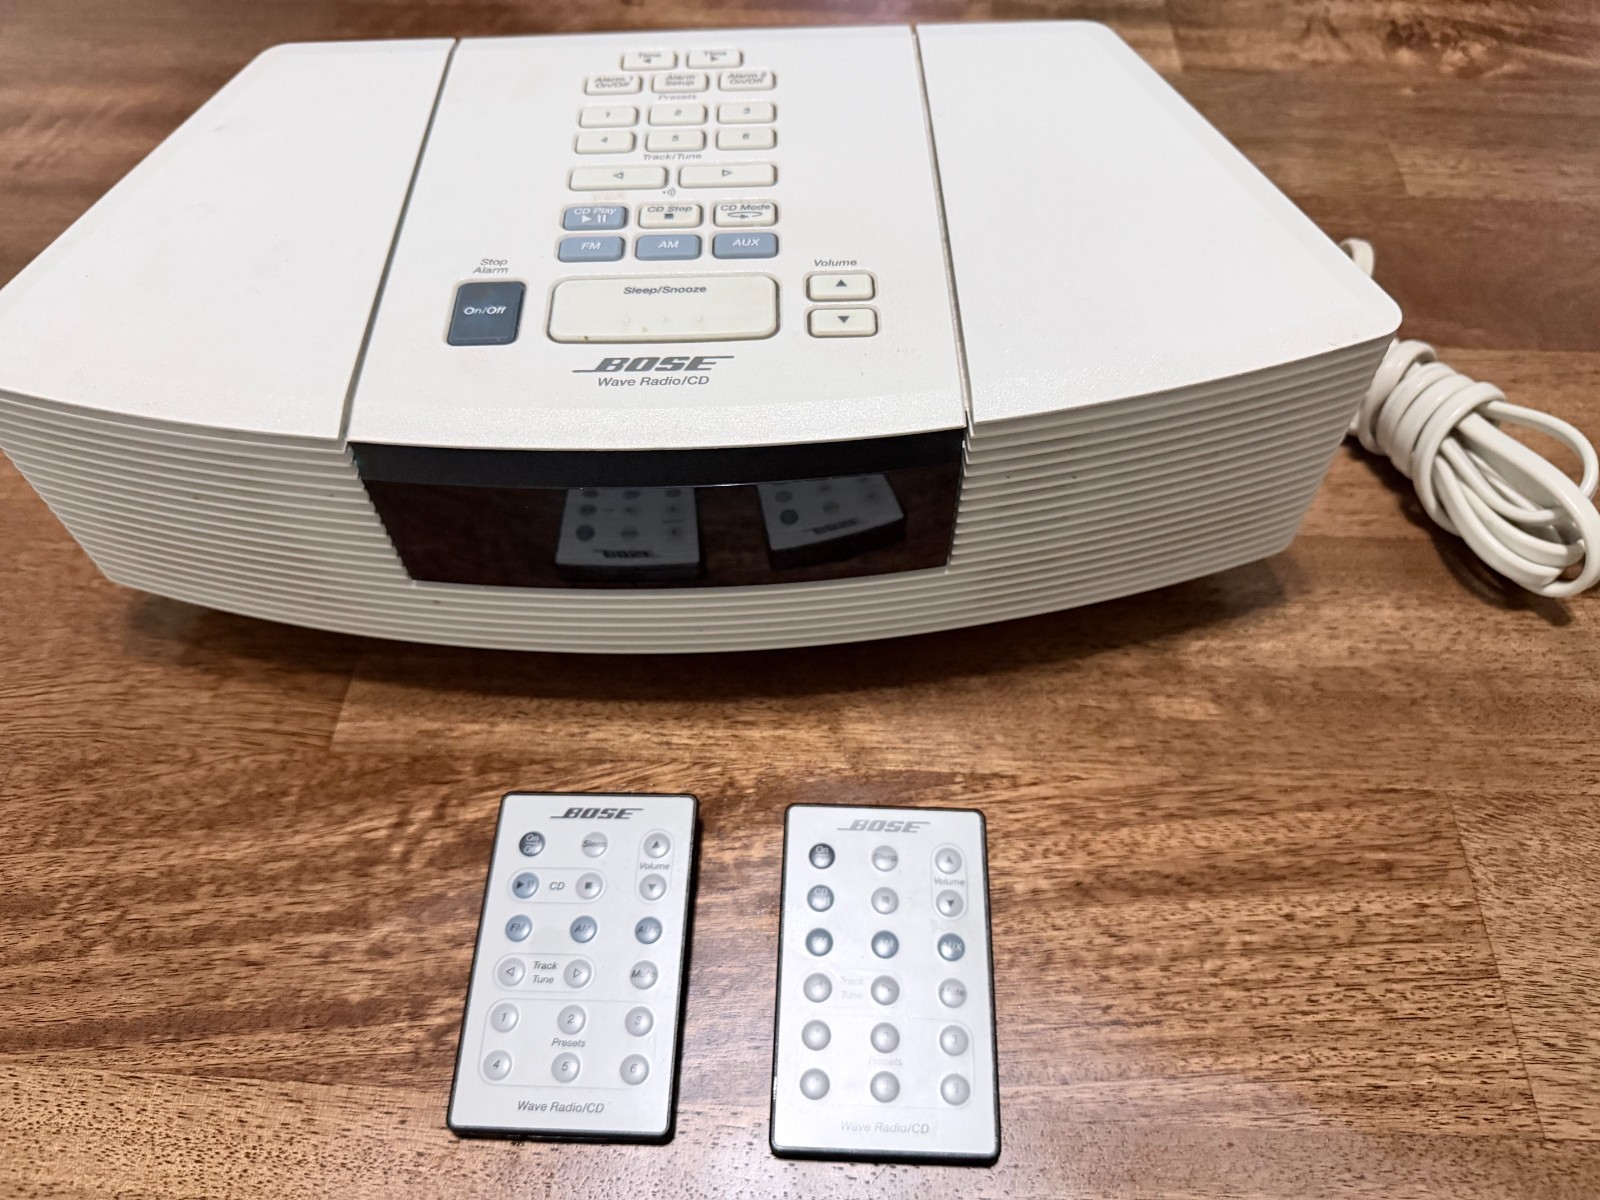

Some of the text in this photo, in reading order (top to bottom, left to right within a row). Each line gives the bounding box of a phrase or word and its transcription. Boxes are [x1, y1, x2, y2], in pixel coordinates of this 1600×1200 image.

[593, 207, 616, 216] Play
[667, 206, 692, 214] Stop
[581, 242, 601, 250] FM
[658, 240, 679, 249] AM
[733, 238, 760, 247] AUX
[480, 258, 508, 267] Stop
[814, 259, 857, 267] Volume
[473, 266, 508, 274] Alarm
[623, 285, 707, 296] Sleep/Snooze
[464, 305, 507, 315] On/Off
[573, 355, 734, 373] BOSE
[598, 375, 710, 386] Wave Radio/CD
[550, 808, 644, 819] BOSE
[837, 819, 930, 833] BOSE
[526, 834, 539, 842] On
[640, 862, 670, 870] Volume
[549, 882, 565, 890] CD
[934, 877, 965, 886] Volume
[533, 961, 557, 970] Track
[532, 975, 554, 983] Tune
[501, 1013, 507, 1022] 1
[567, 1015, 575, 1024] 2
[551, 1038, 586, 1047] Presets
[493, 1060, 500, 1069] 4
[561, 1061, 569, 1071] 5
[630, 1063, 637, 1073] 6
[517, 1101, 604, 1113] Wave Radio/CD
[875, 1122, 930, 1134] Radio/CD
